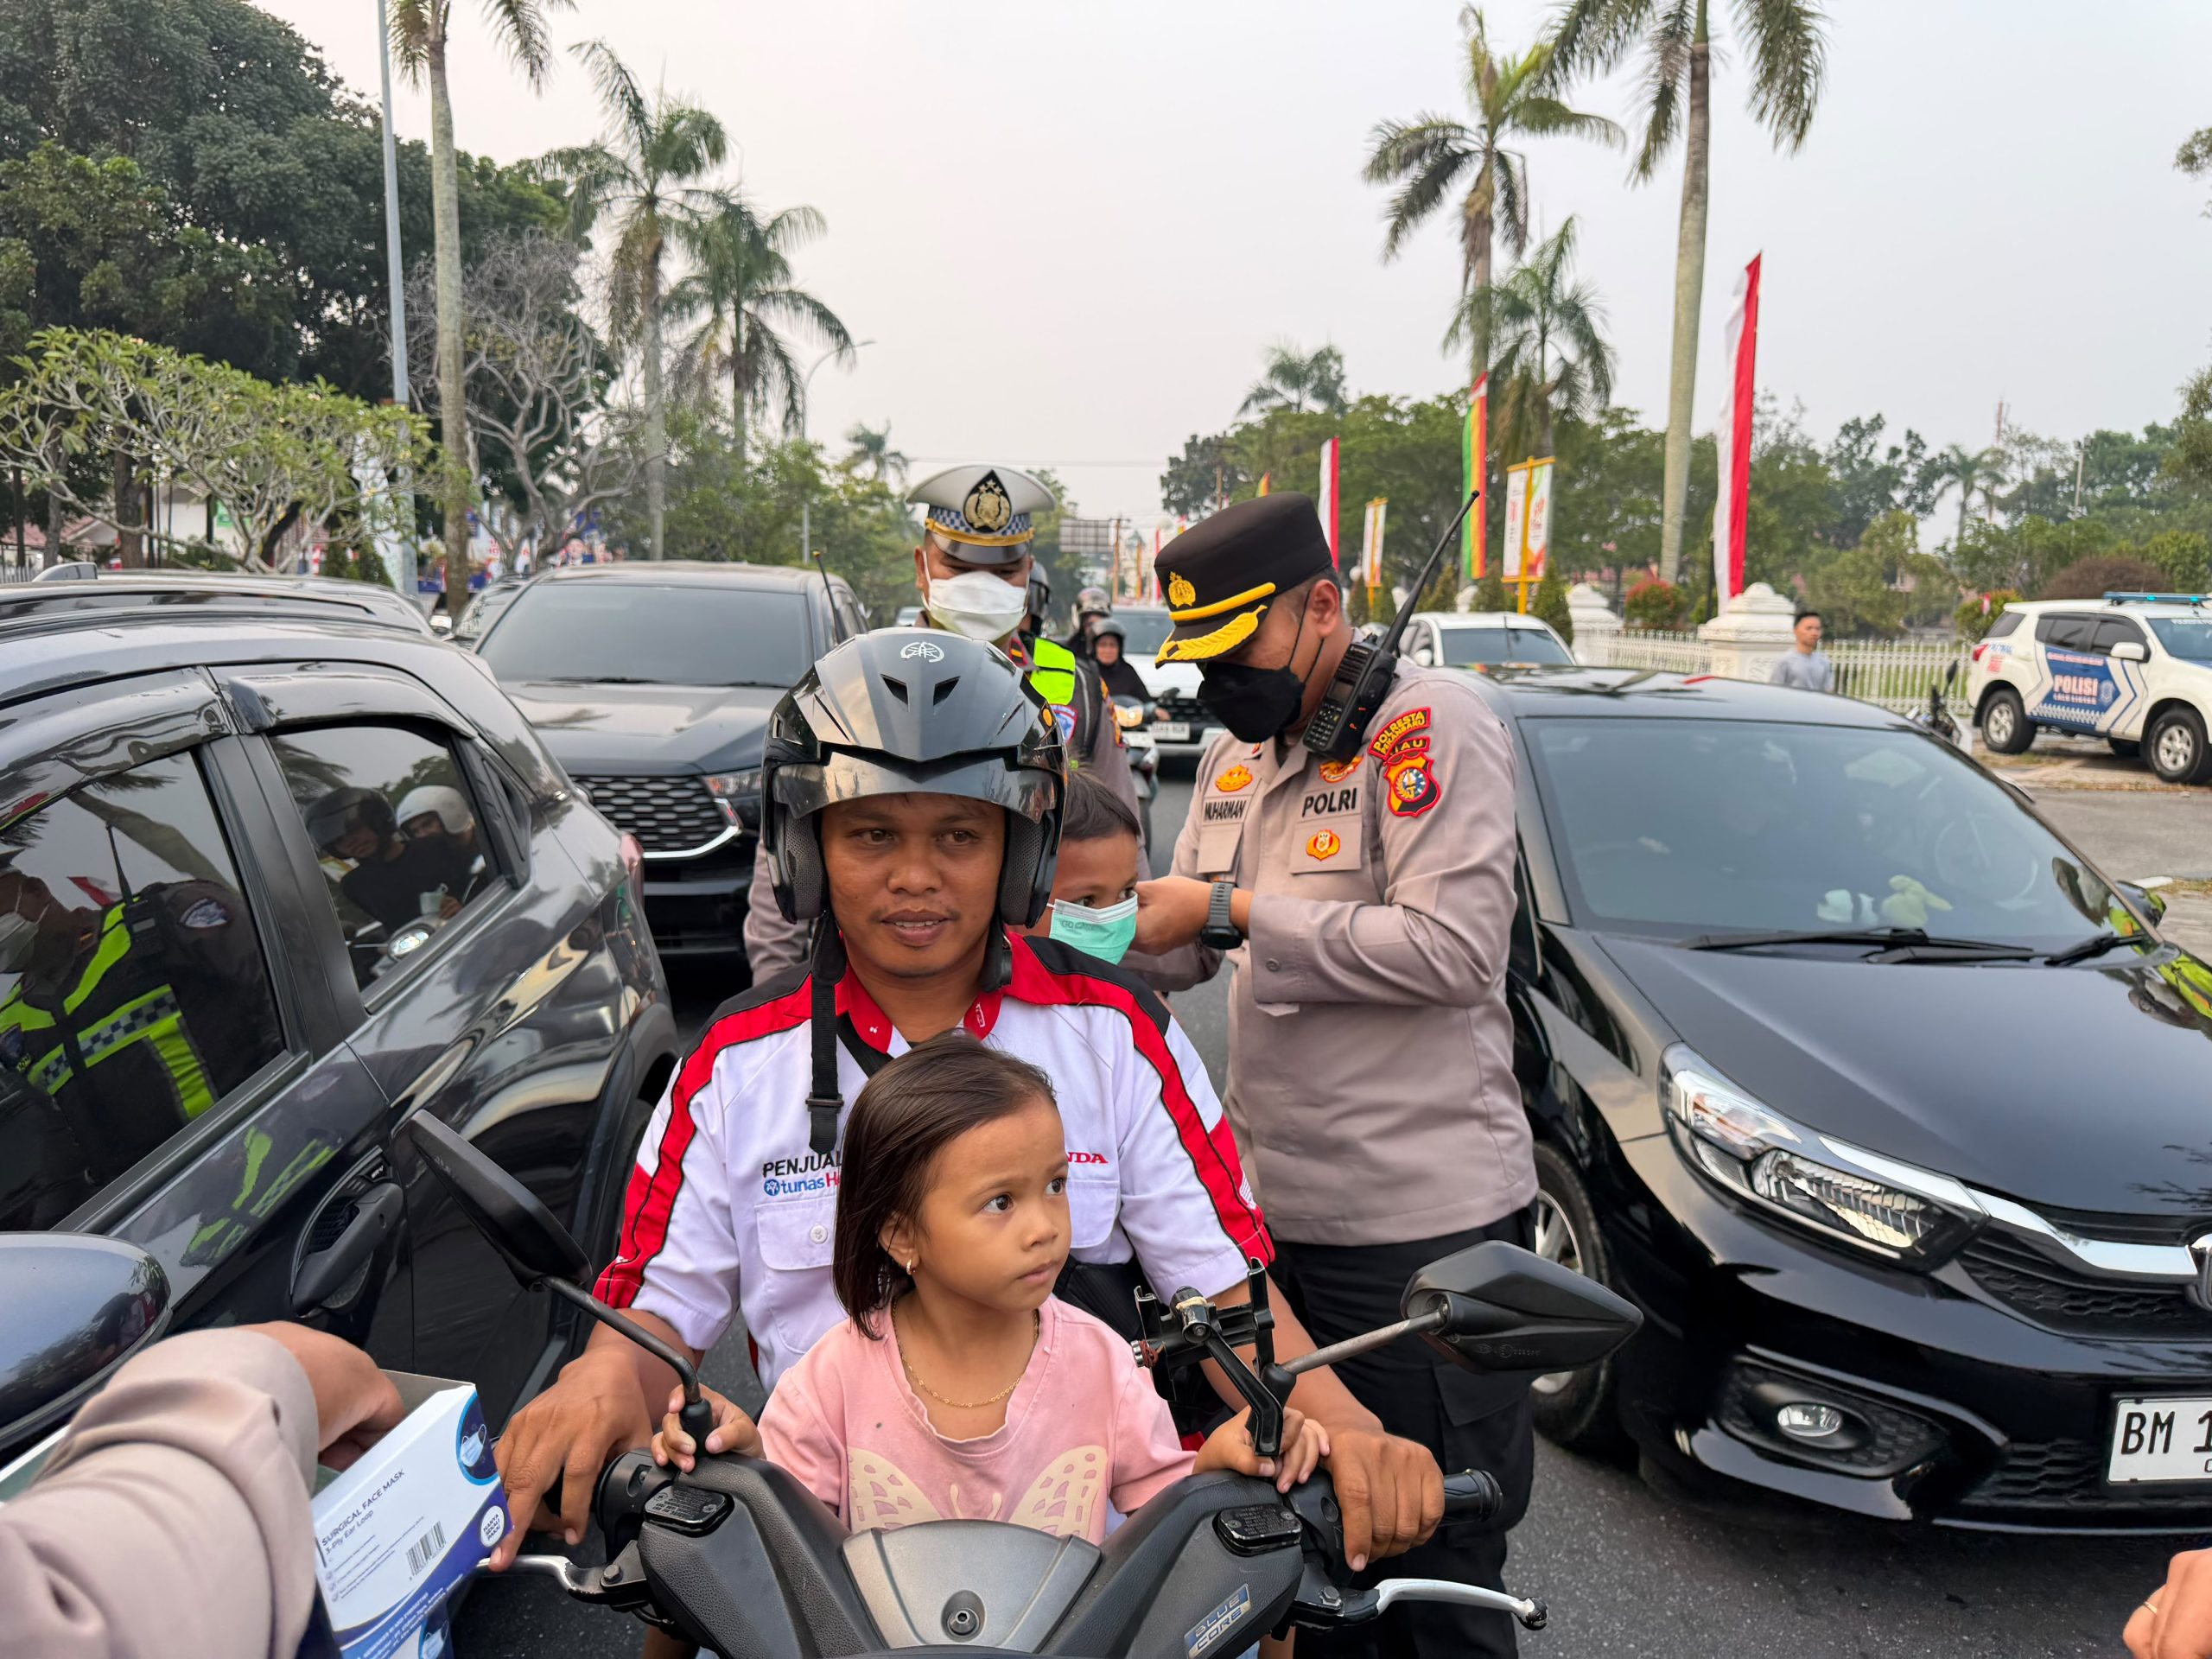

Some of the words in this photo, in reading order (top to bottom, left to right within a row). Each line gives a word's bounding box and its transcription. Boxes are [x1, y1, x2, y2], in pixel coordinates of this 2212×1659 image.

[2054, 675, 2098, 696] POLISI
[1373, 711, 1425, 752] POLRESTA
[1380, 720, 1425, 755] PEKANBARU
[1389, 739, 1423, 756] IAU
[1204, 799, 1247, 821] MUHARMAN
[1301, 787, 1357, 817] POLRI
[2120, 1410, 2175, 1454] BM
[2193, 1409, 2212, 1453] 1
[321, 1509, 362, 1547] SURGICAL
[362, 1488, 383, 1510] FACE
[382, 1468, 404, 1491] MASK
[1195, 1594, 1240, 1637] BLUE
[1197, 1607, 1242, 1650] CORE
